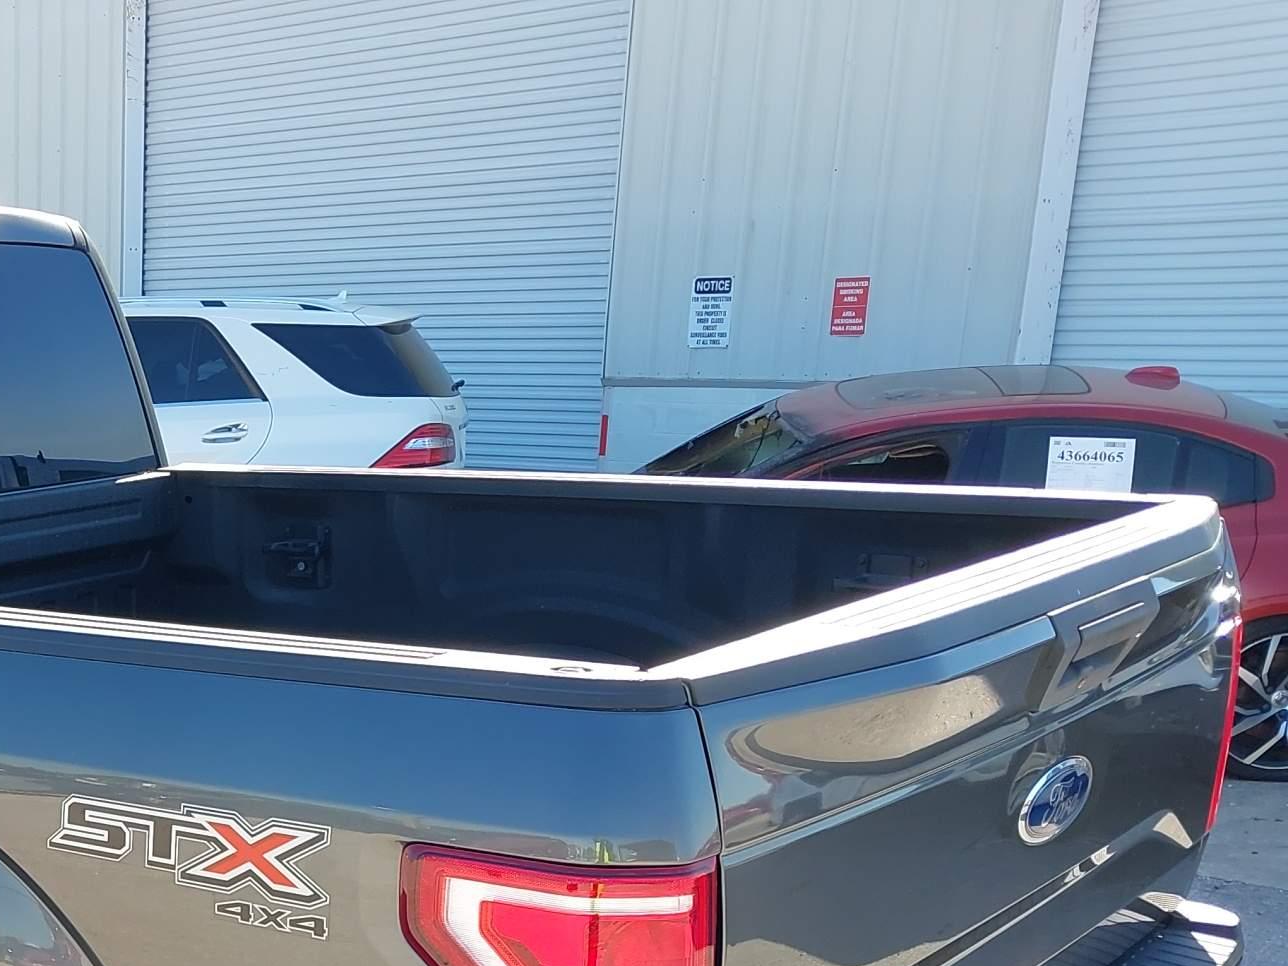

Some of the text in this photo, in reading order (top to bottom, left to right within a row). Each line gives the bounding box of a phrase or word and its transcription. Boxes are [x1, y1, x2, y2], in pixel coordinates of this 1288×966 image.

[696, 280, 730, 292] NOTICE
[1057, 450, 1124, 462] 43664065
[47, 793, 332, 910] STX
